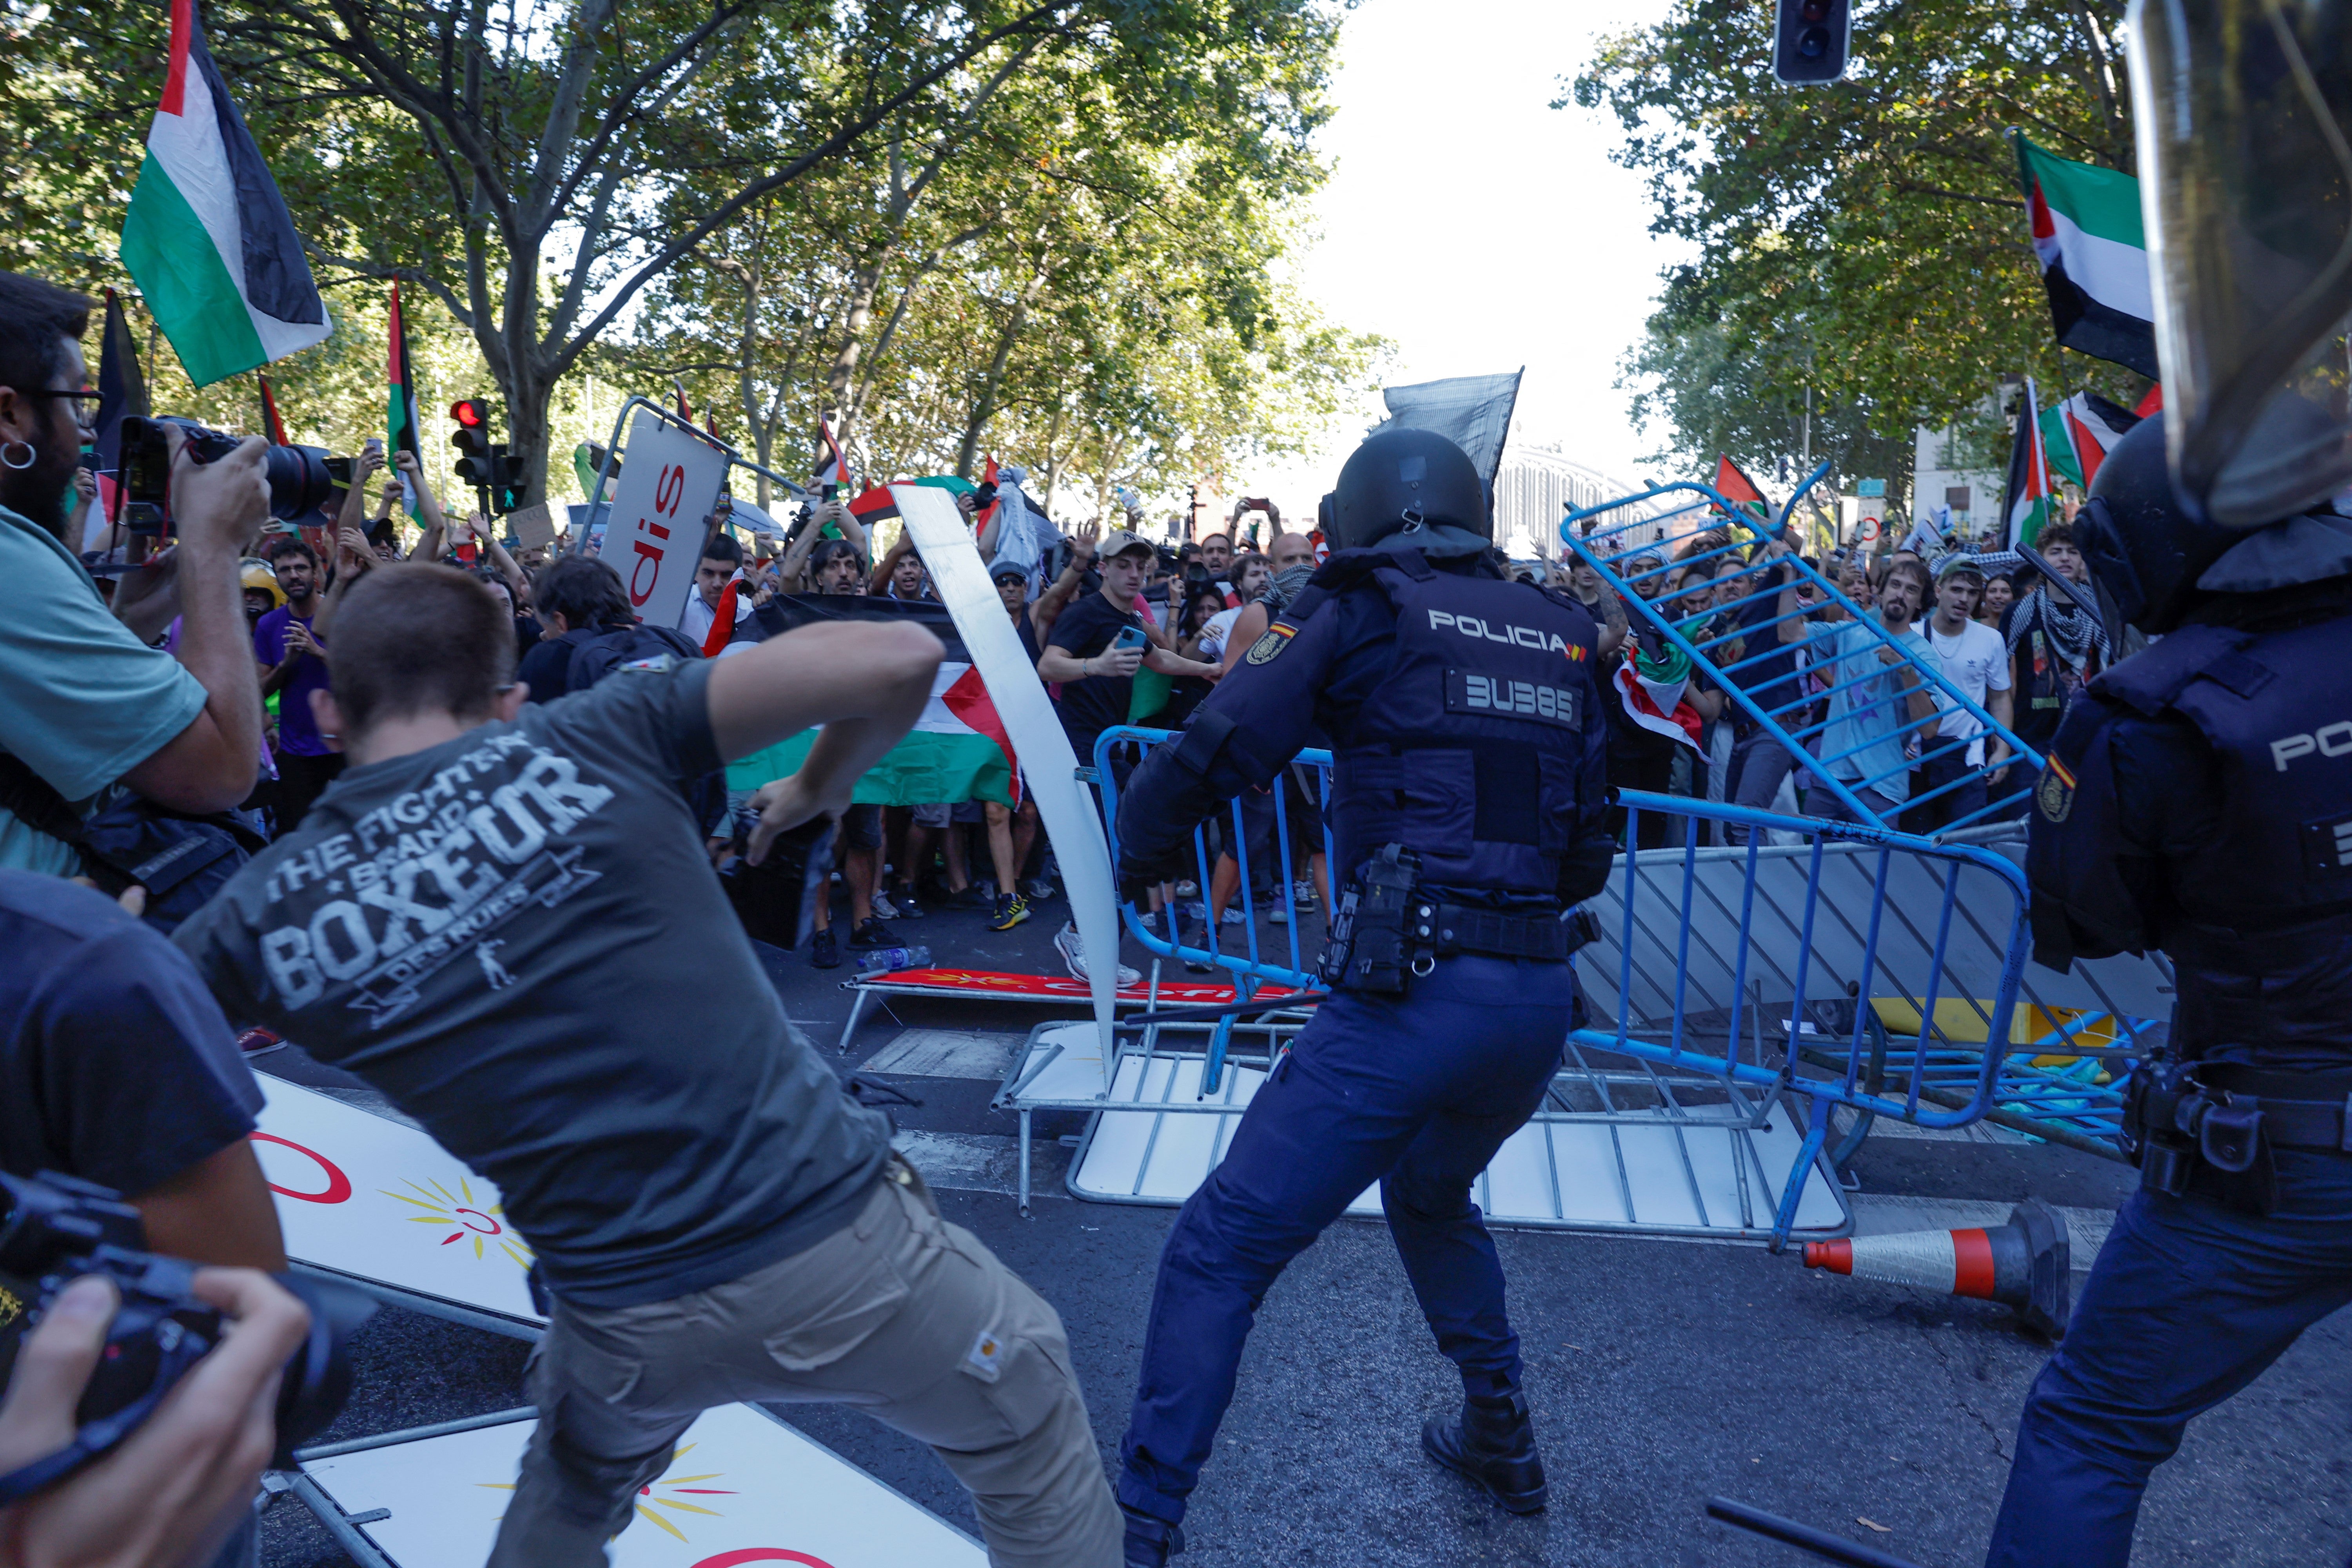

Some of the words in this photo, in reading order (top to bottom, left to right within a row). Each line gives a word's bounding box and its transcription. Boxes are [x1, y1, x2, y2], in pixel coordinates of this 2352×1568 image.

[630, 464, 684, 623] dis
[1428, 609, 1570, 655] POLICIA
[261, 755, 615, 1011] BOXEUR
[348, 800, 466, 890] BRAND
